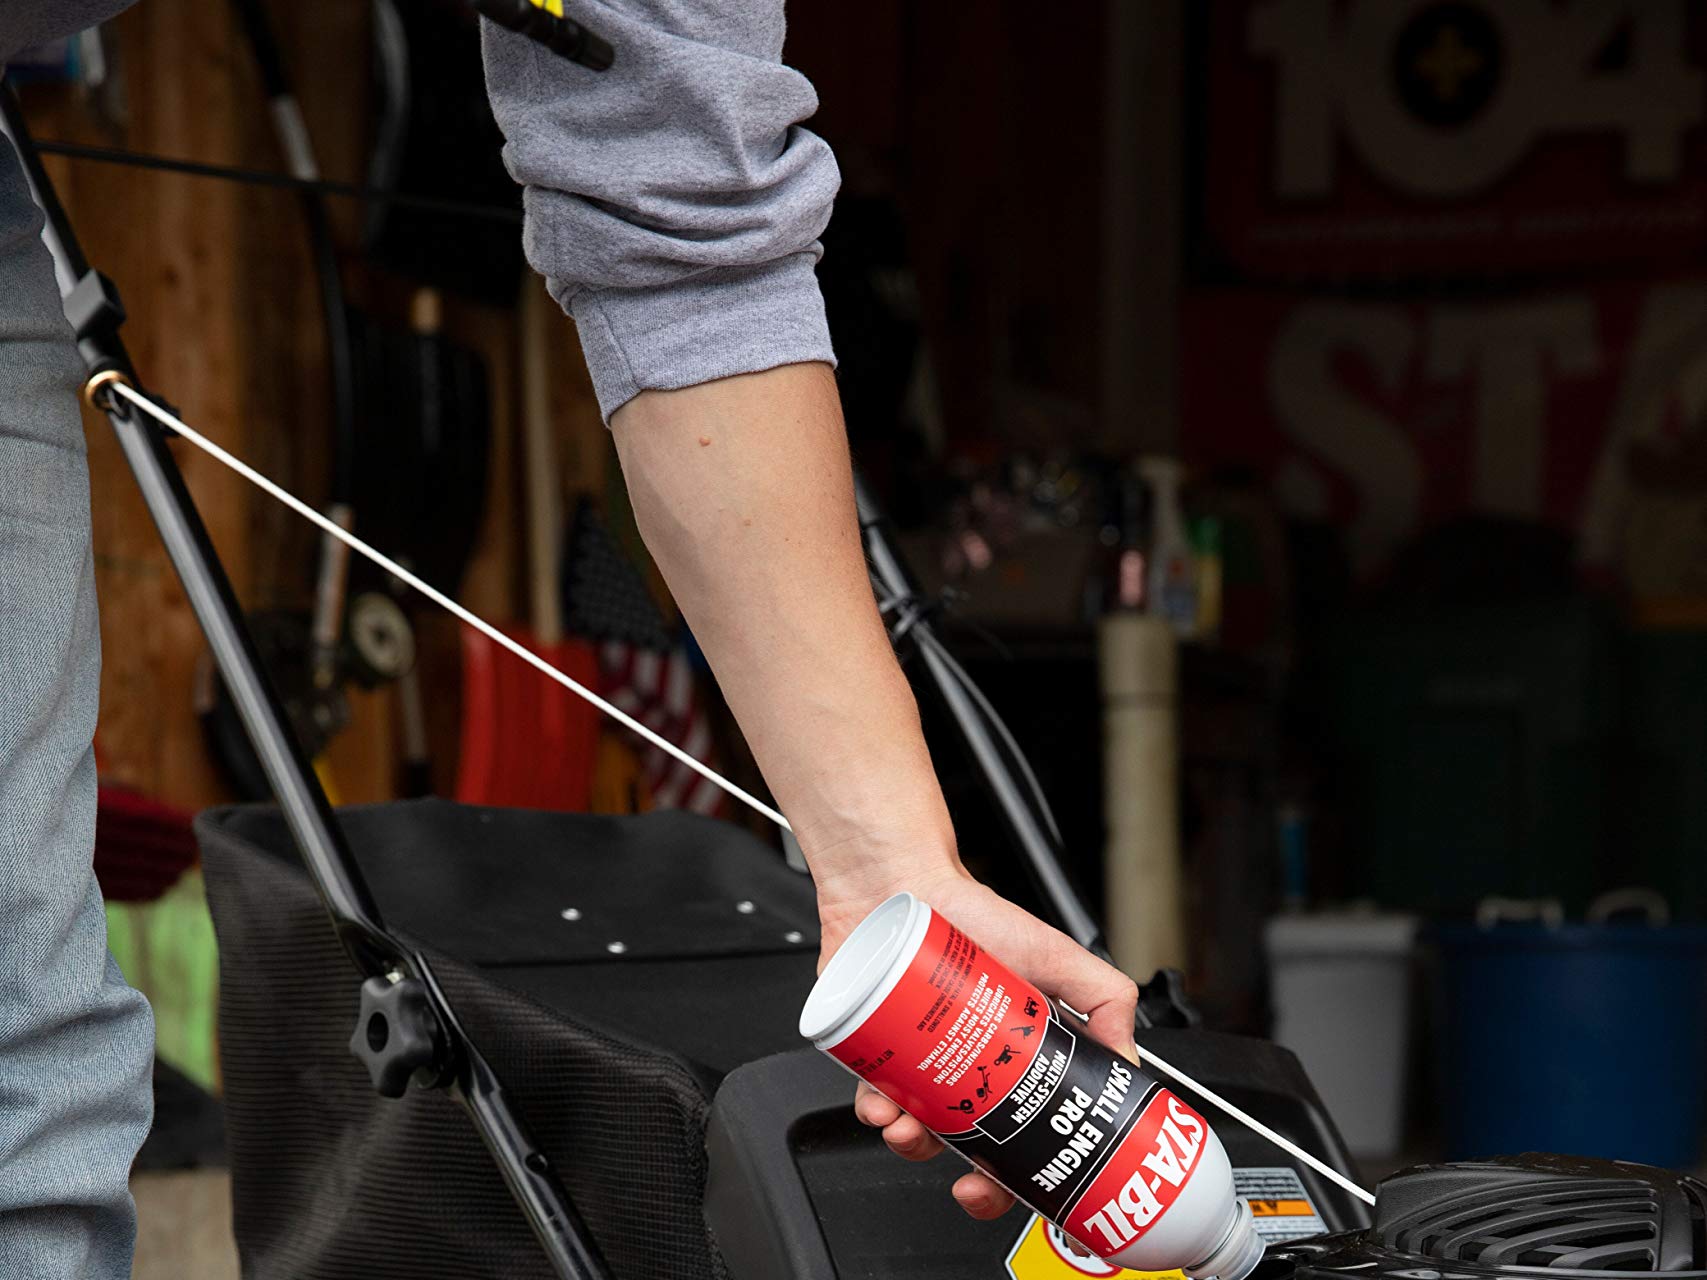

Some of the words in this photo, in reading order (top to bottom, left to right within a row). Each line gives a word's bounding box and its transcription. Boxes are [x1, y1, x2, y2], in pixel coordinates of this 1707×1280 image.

[967, 972, 989, 1008] PROTECTS
[975, 987, 994, 1014] QUIETS
[979, 985, 1005, 1028] LUBRICATES
[994, 995, 1012, 1024] CLEANS
[945, 1007, 971, 1042] AGAINST
[962, 1013, 980, 1039] NOISY
[917, 1040, 947, 1072] ETHANOL
[933, 1027, 984, 1085] VALVES/PISTONS
[934, 1038, 963, 1070] ENGINES
[945, 1023, 998, 1086] CARBS/INJECTORS
[1010, 1053, 1050, 1105] ADDITIVE
[1011, 1050, 1068, 1124] MULTI-SYSTEM
[1091, 1060, 1132, 1124] SMALL
[1050, 1086, 1093, 1135] PRO
[1031, 1121, 1104, 1192] ENGINE
[1083, 1097, 1203, 1249] STA-BIL
